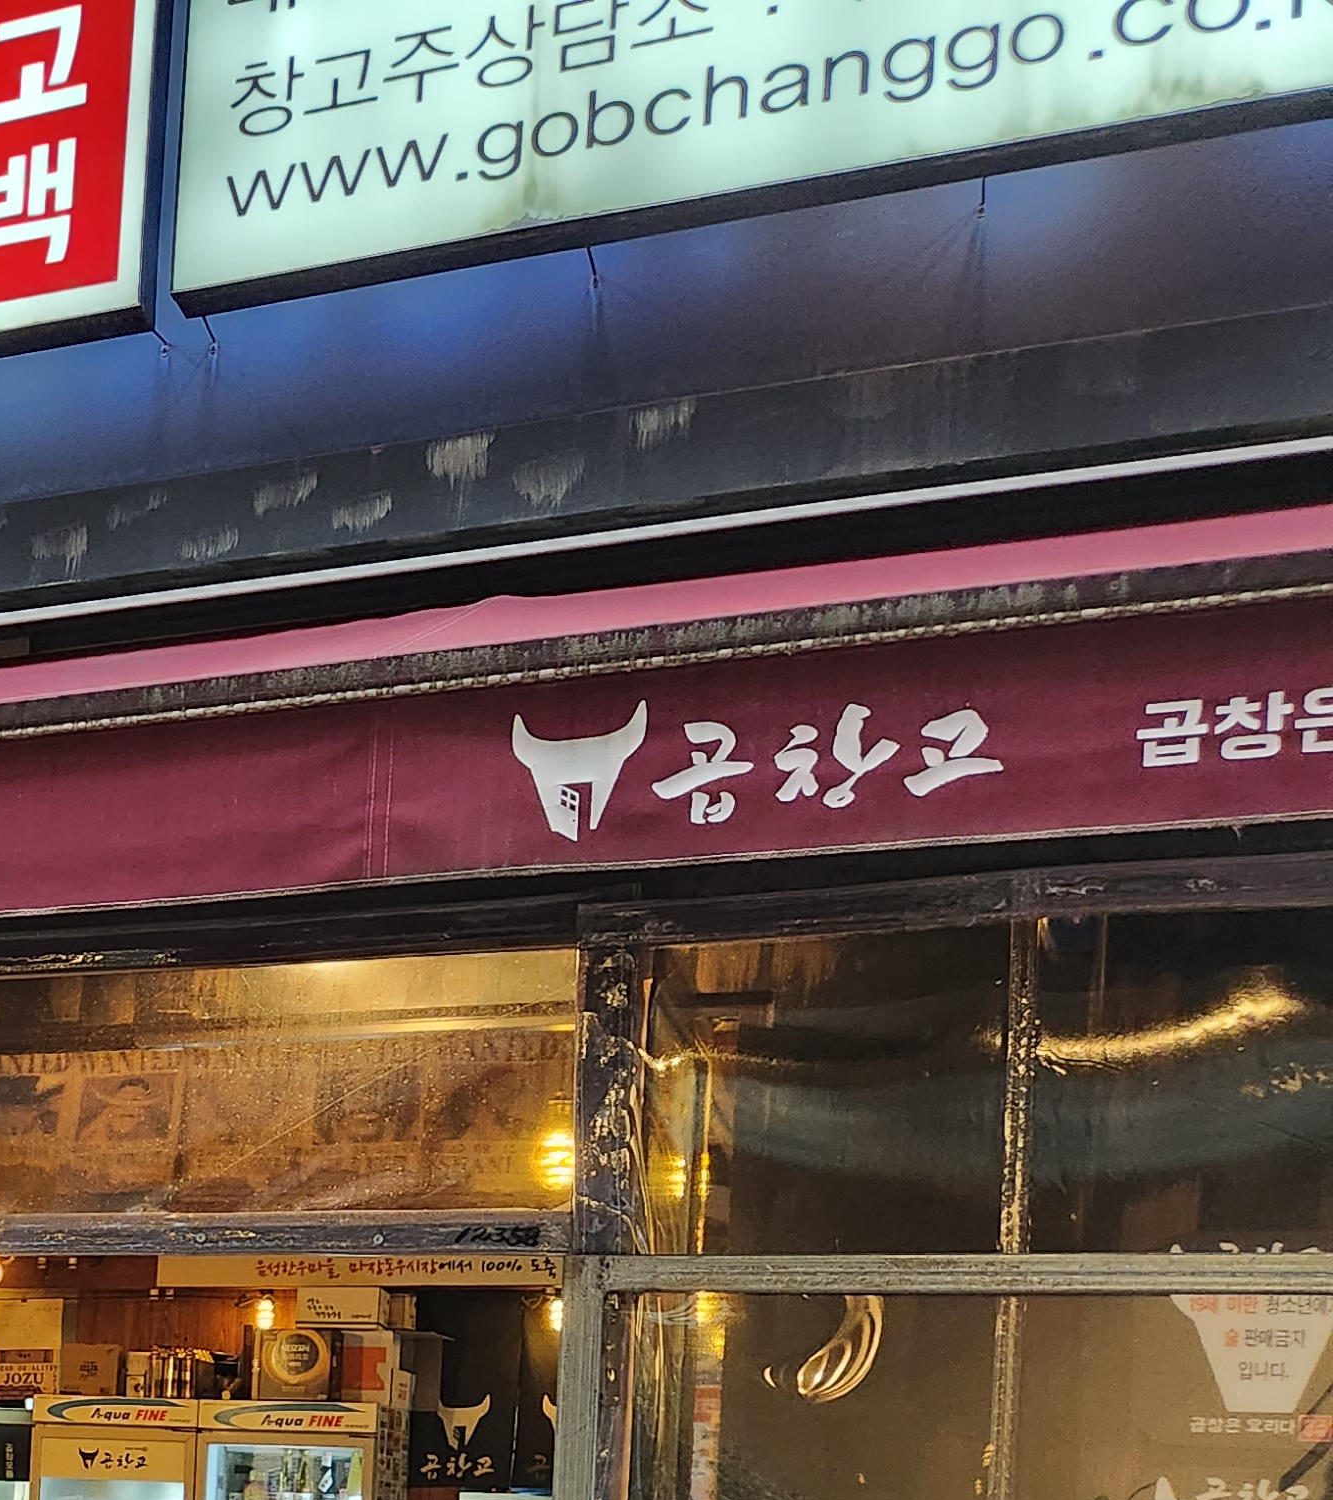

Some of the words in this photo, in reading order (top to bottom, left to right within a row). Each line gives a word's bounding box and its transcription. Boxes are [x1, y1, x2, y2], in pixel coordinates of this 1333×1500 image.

[226, 0, 1333, 218] www.gobchanggo.co.
[651, 703, 1004, 825] 곱창고
[481, 1256, 523, 1273] 100%
[1264, 1296, 1333, 1316] 청소년에
[1244, 1328, 1306, 1348] 판매금지
[3, 1371, 47, 1387] JOZU
[134, 1408, 168, 1422] FINE
[308, 1415, 344, 1428] FINE
[420, 1452, 495, 1481] 곱창고
